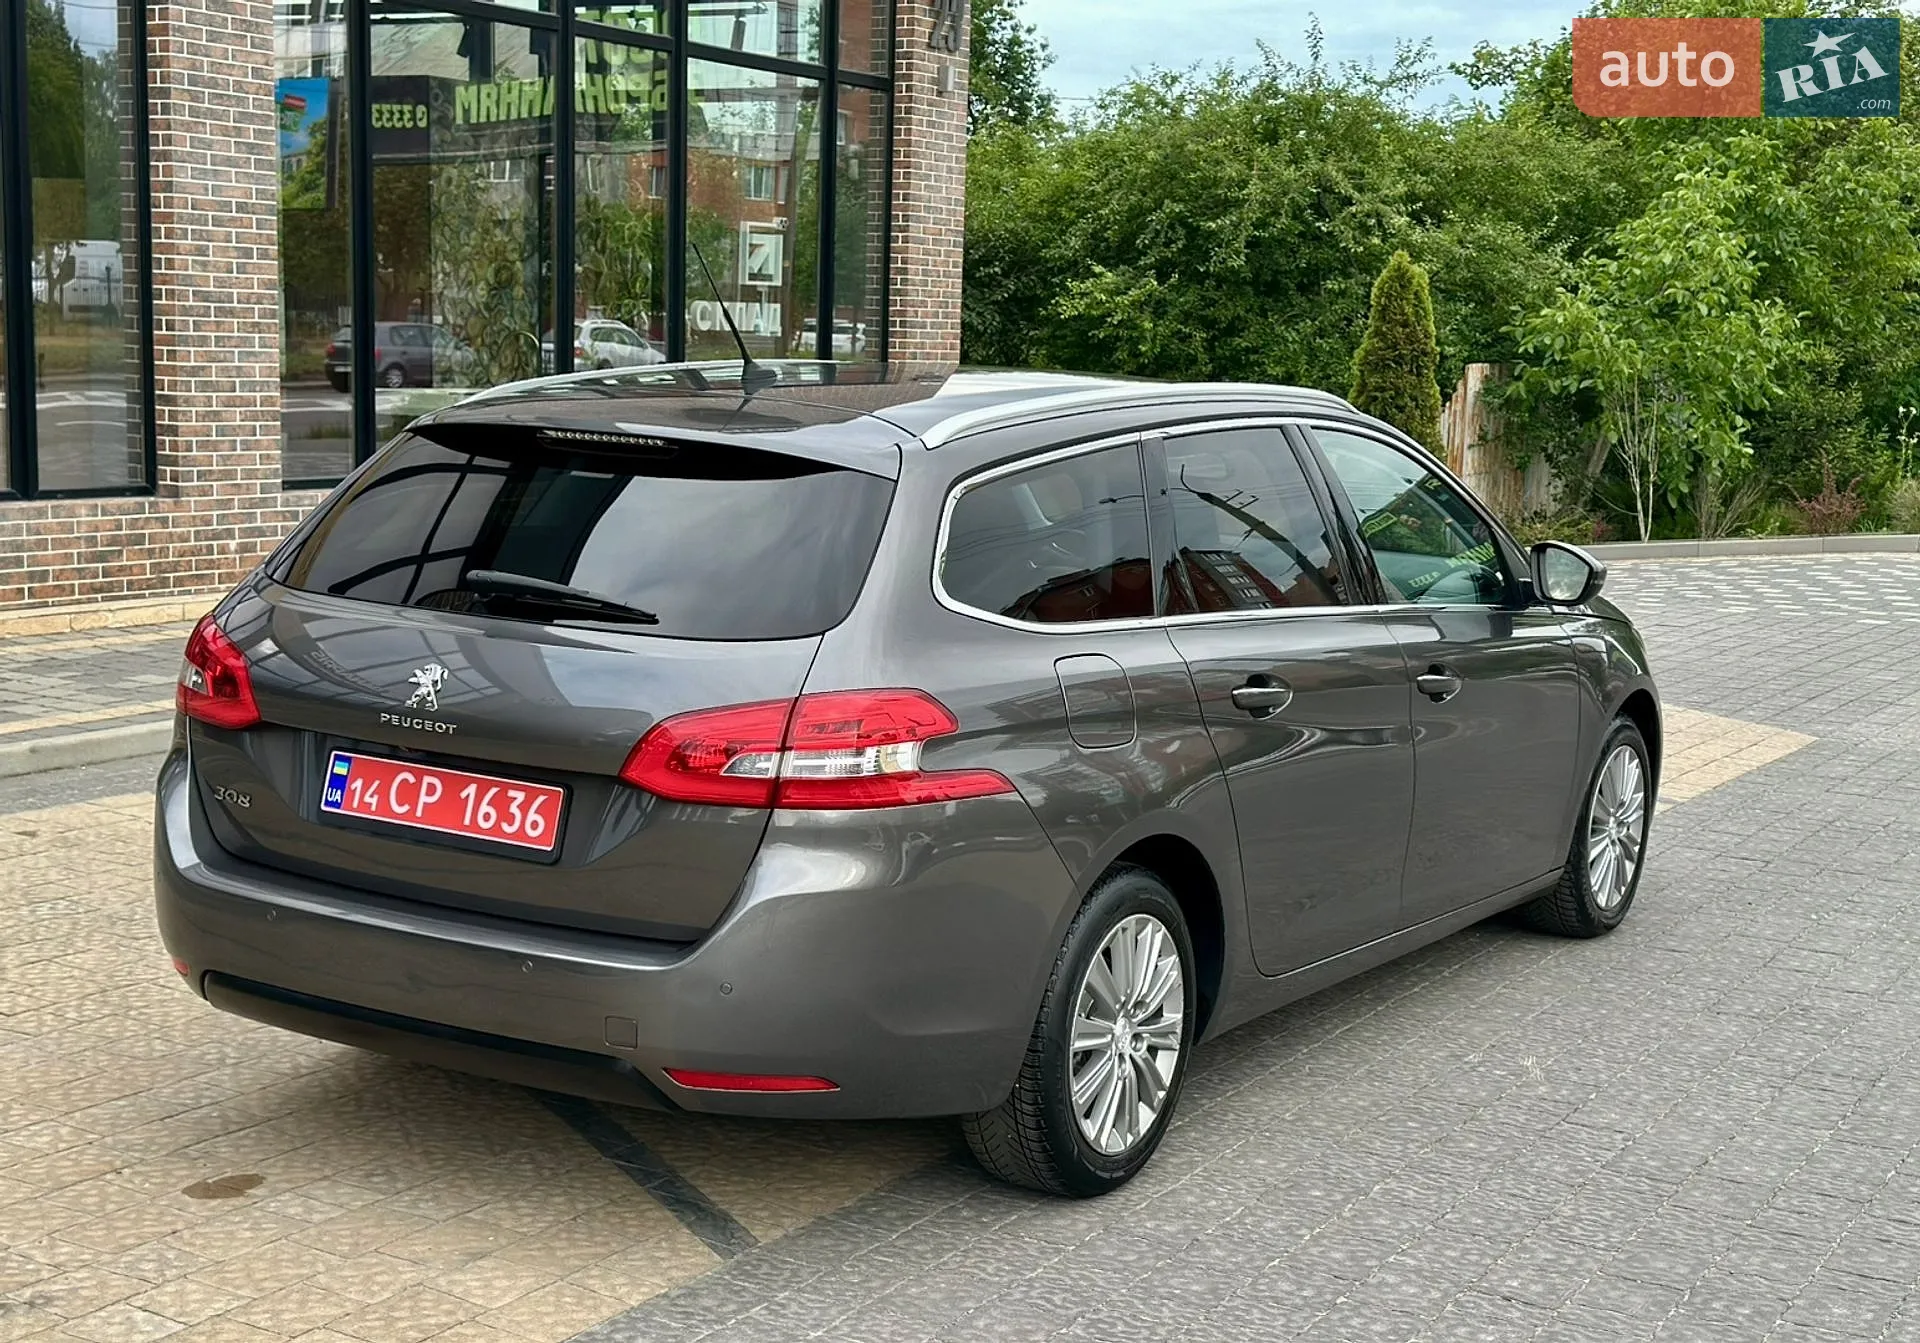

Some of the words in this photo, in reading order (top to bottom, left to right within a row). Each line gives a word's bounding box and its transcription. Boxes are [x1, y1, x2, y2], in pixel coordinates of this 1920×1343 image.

[379, 711, 458, 735] PEUGEOT
[214, 785, 252, 808] 308
[326, 786, 342, 804] UA
[350, 776, 381, 812] 14
[389, 771, 443, 818] CP
[459, 782, 549, 838] 1636
